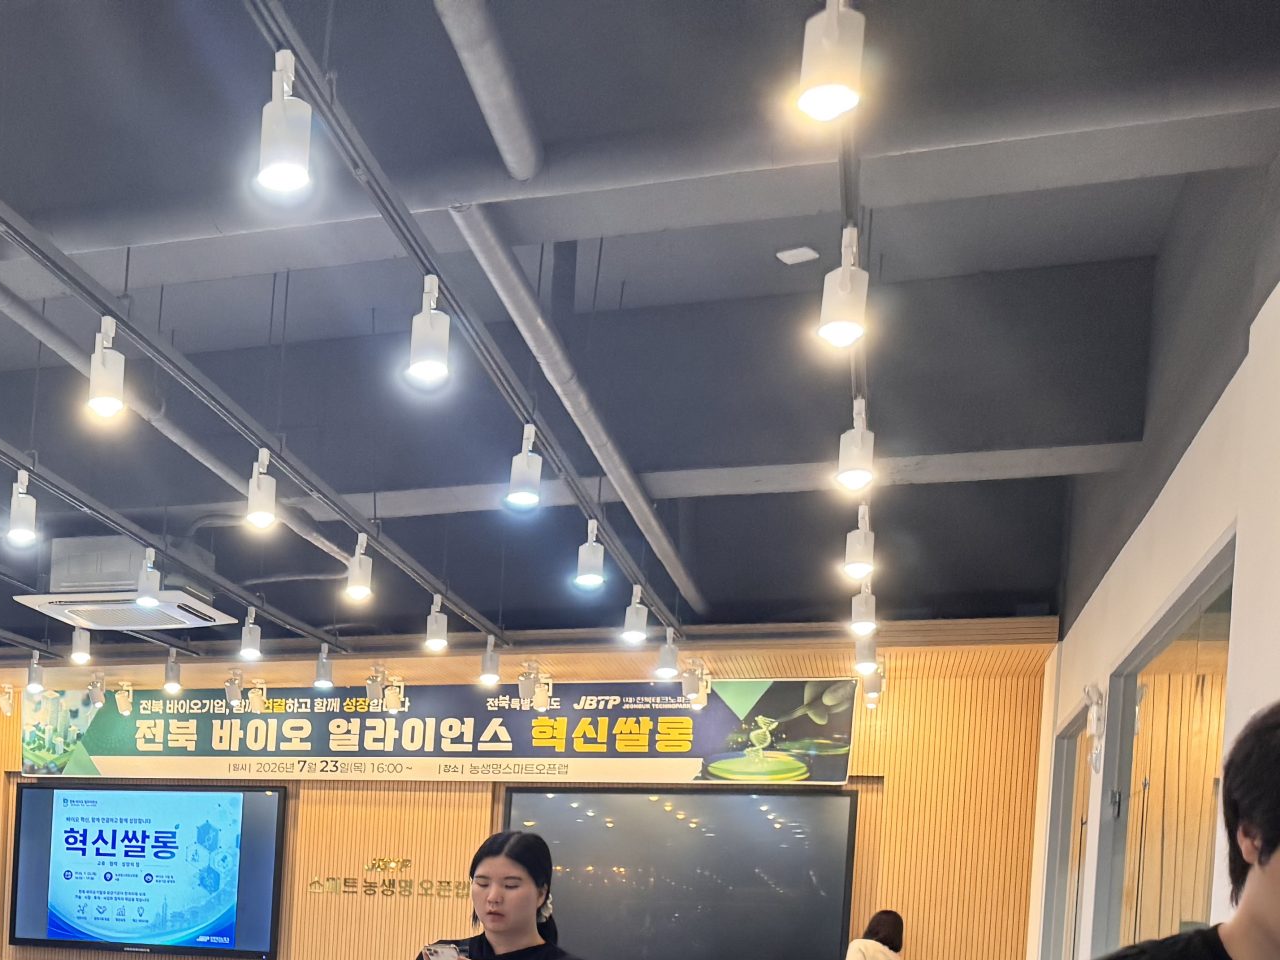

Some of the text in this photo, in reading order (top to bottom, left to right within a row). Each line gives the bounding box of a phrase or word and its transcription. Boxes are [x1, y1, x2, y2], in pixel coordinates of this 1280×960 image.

[139, 699, 163, 714] 전북
[166, 699, 229, 715] 바이오기업,
[314, 698, 340, 713] 함께
[573, 696, 621, 710] JBTP
[134, 716, 694, 753] 전북 바이오 얼라이언스 혁신쌀롱
[256, 762, 295, 773] 2026년
[297, 760, 317, 773] 7월
[320, 760, 366, 774] 23일(목)
[371, 762, 403, 774] 16:00
[469, 763, 569, 775] 농생명스마트오픈랩
[63, 827, 180, 860] 혁신쌀롱
[363, 878, 413, 897] 농생명
